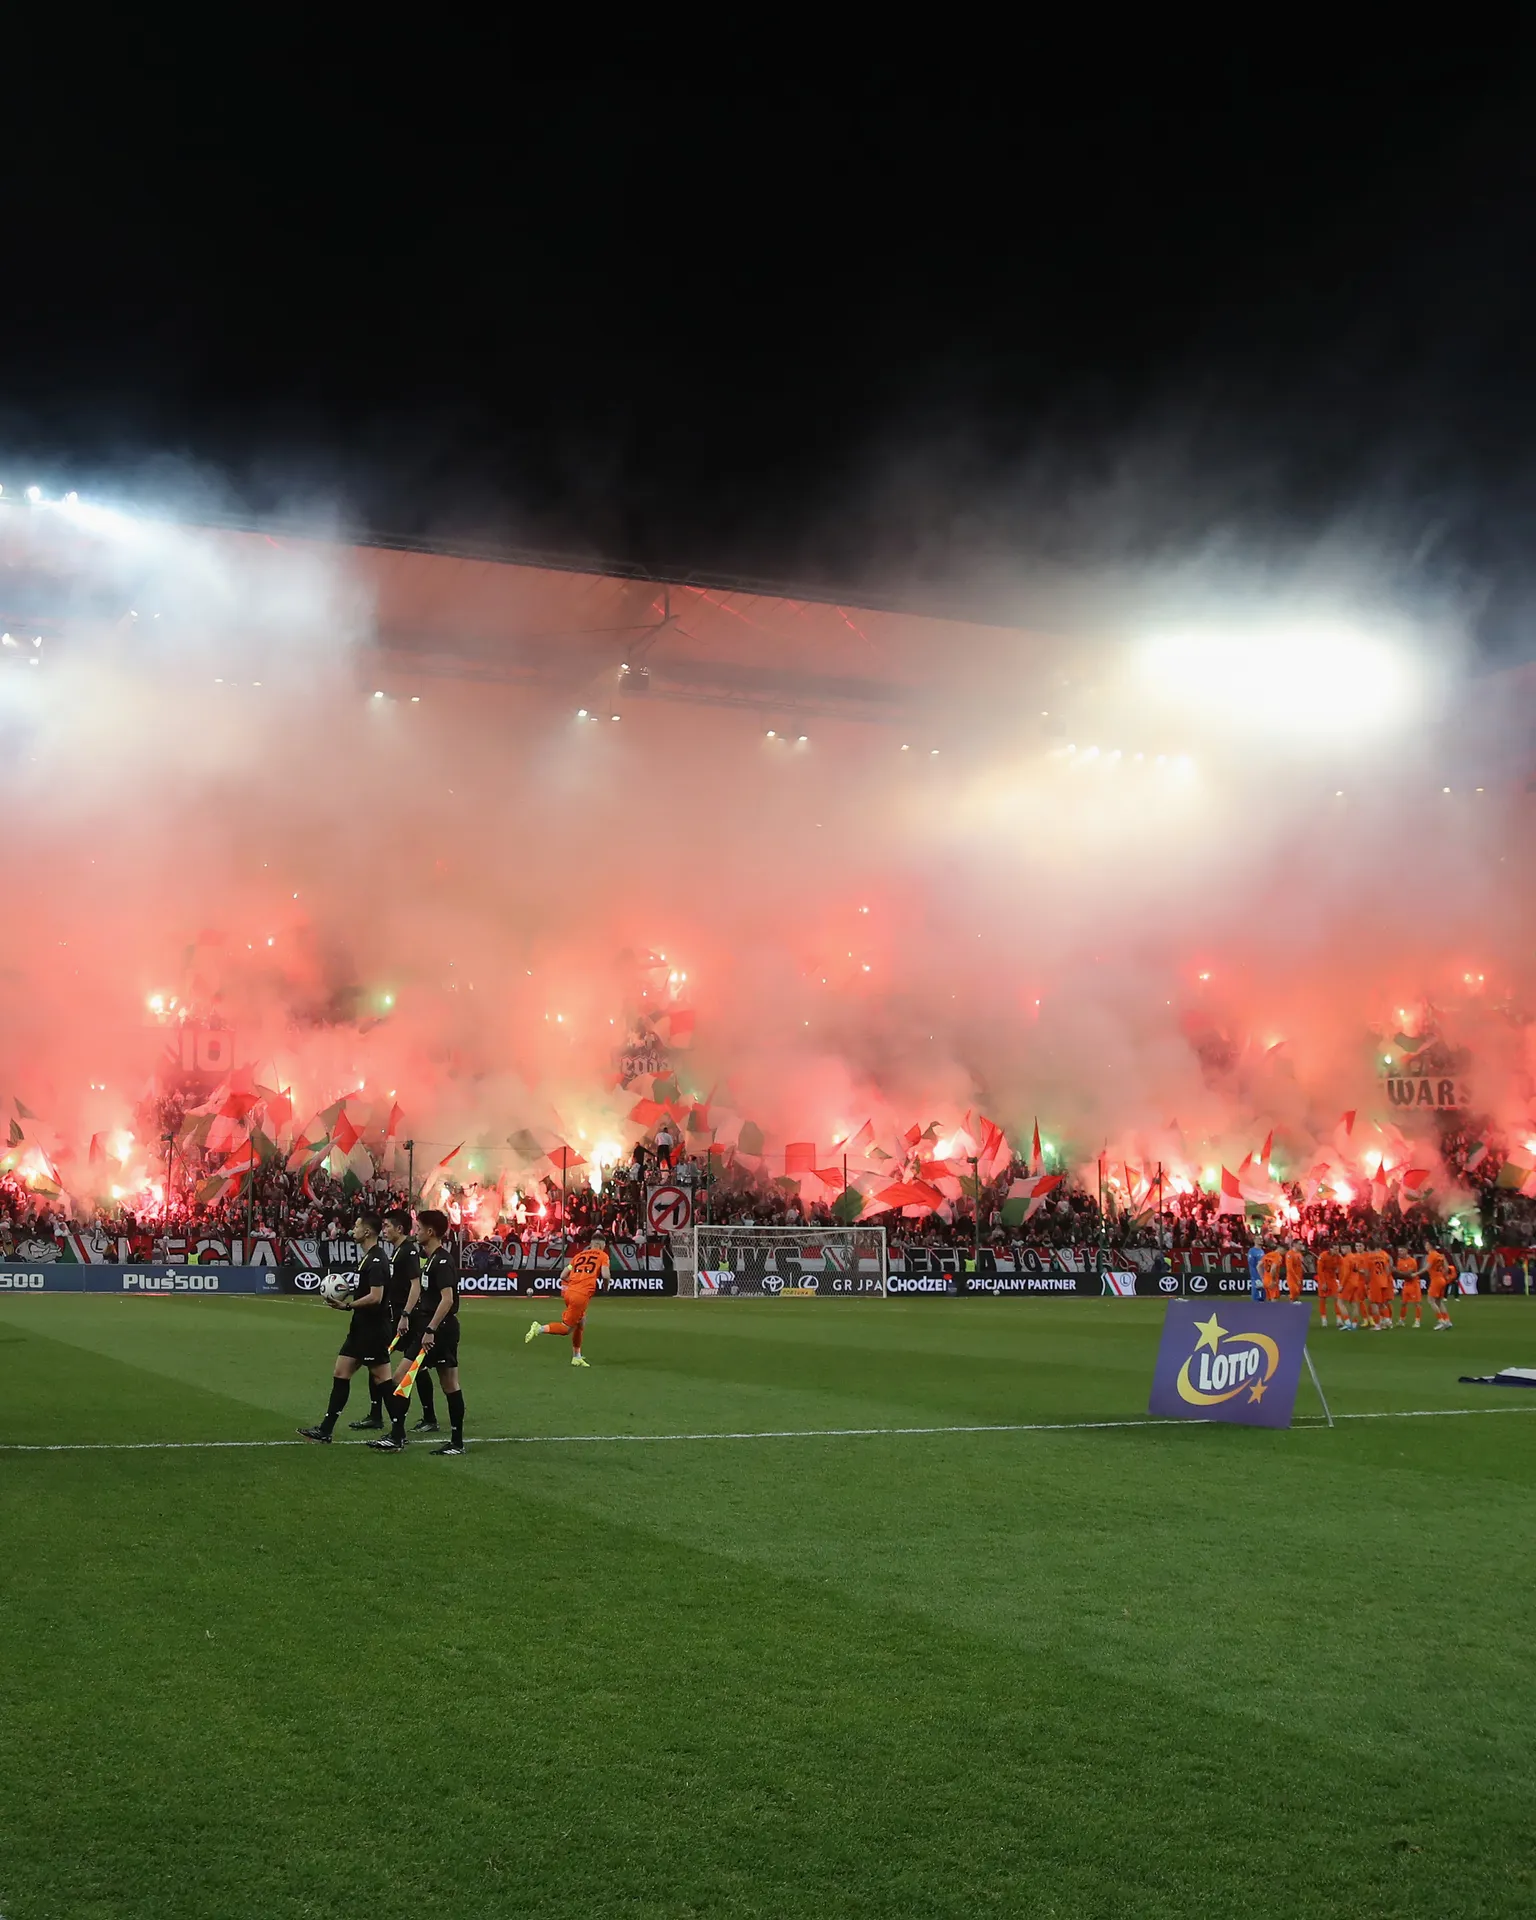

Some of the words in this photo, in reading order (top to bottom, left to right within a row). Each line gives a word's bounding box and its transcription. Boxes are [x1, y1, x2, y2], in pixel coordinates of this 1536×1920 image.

[574, 1256, 597, 1273] 25
[0, 1273, 44, 1288] 500
[123, 1269, 219, 1290] Plus500
[608, 1278, 664, 1290] PARTNER
[966, 1279, 1026, 1290] OFICJALNY
[1028, 1279, 1077, 1290] PARTNER
[1199, 1348, 1259, 1390] LOTTO
